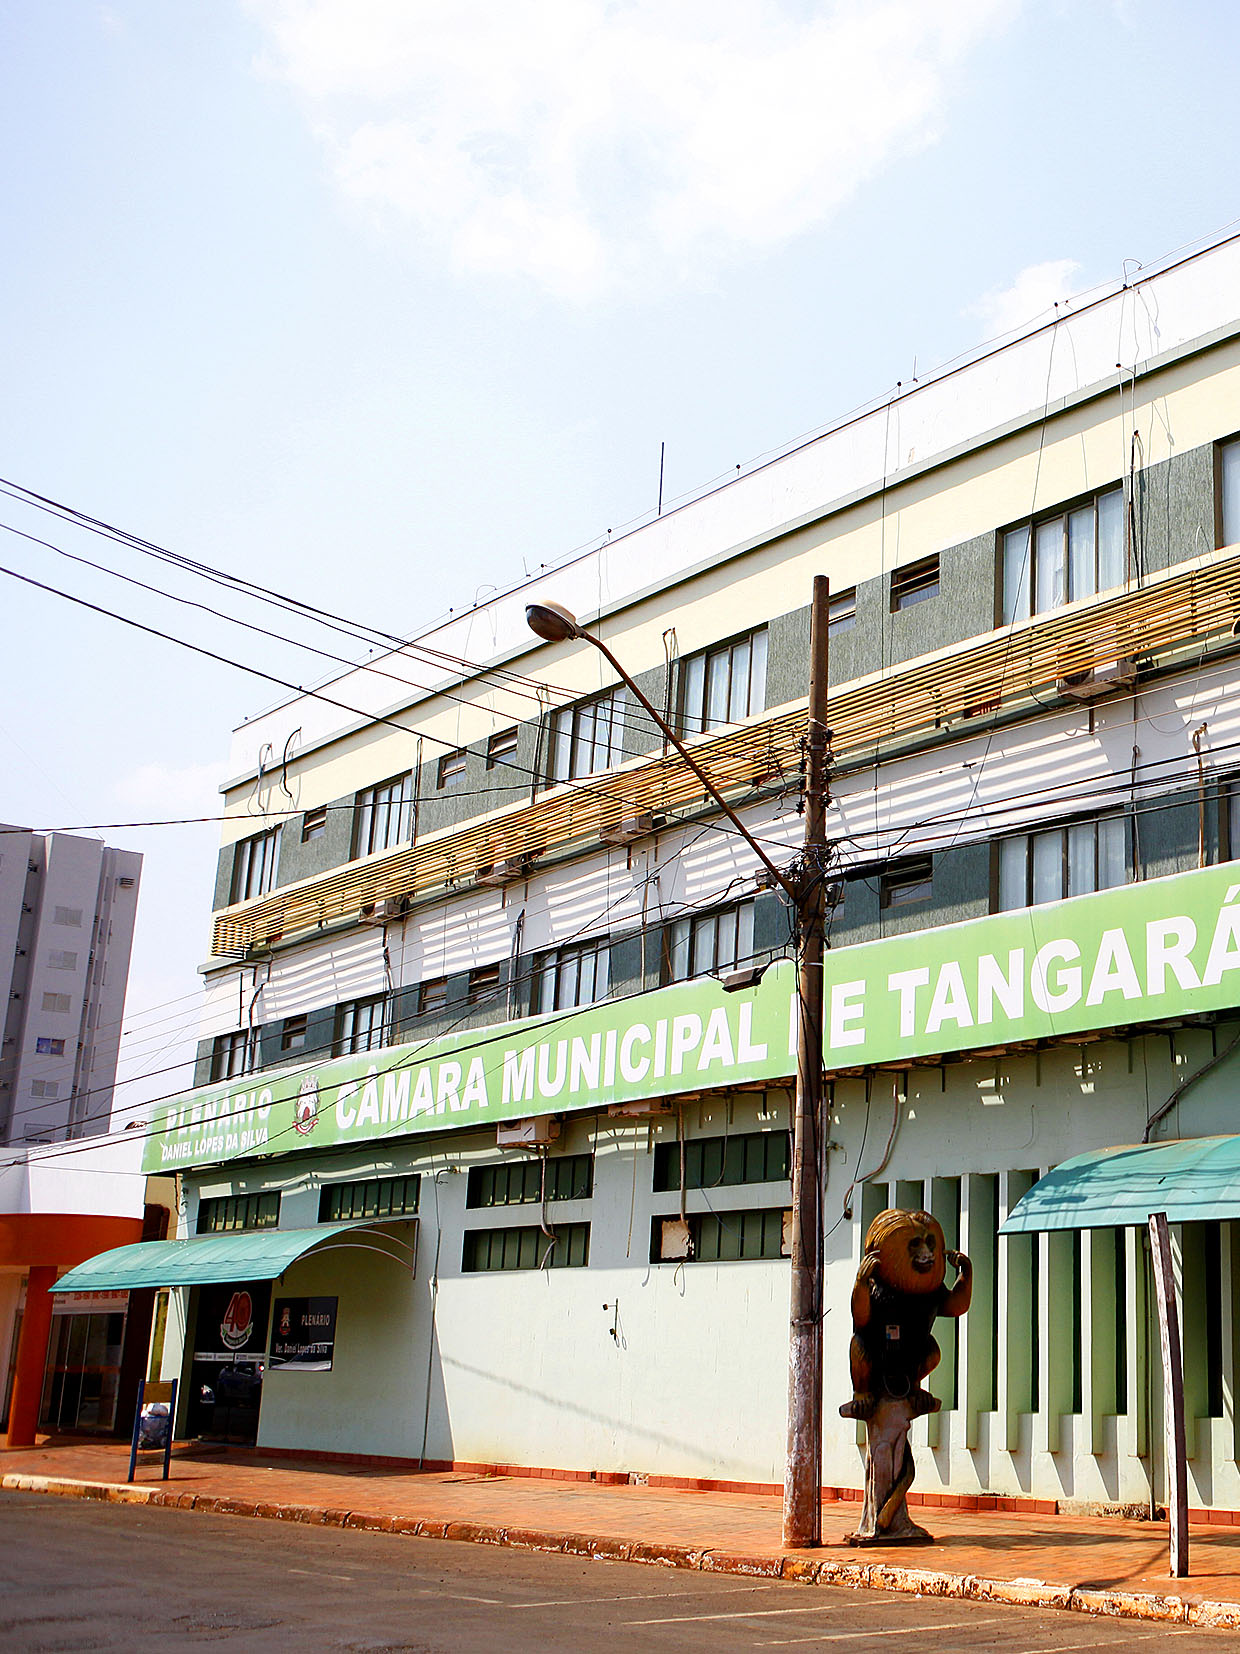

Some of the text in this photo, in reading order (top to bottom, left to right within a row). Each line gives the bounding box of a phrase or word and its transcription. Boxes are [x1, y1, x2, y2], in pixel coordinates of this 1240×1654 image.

[334, 1067, 488, 1130] CÂMARA
[502, 1001, 768, 1104] MUNICIPAL
[166, 1088, 273, 1138] PLENÁRIO
[161, 1128, 268, 1161] DANIEL LOPES DA SILVA
[301, 1312, 330, 1326] PLENÁRIO
